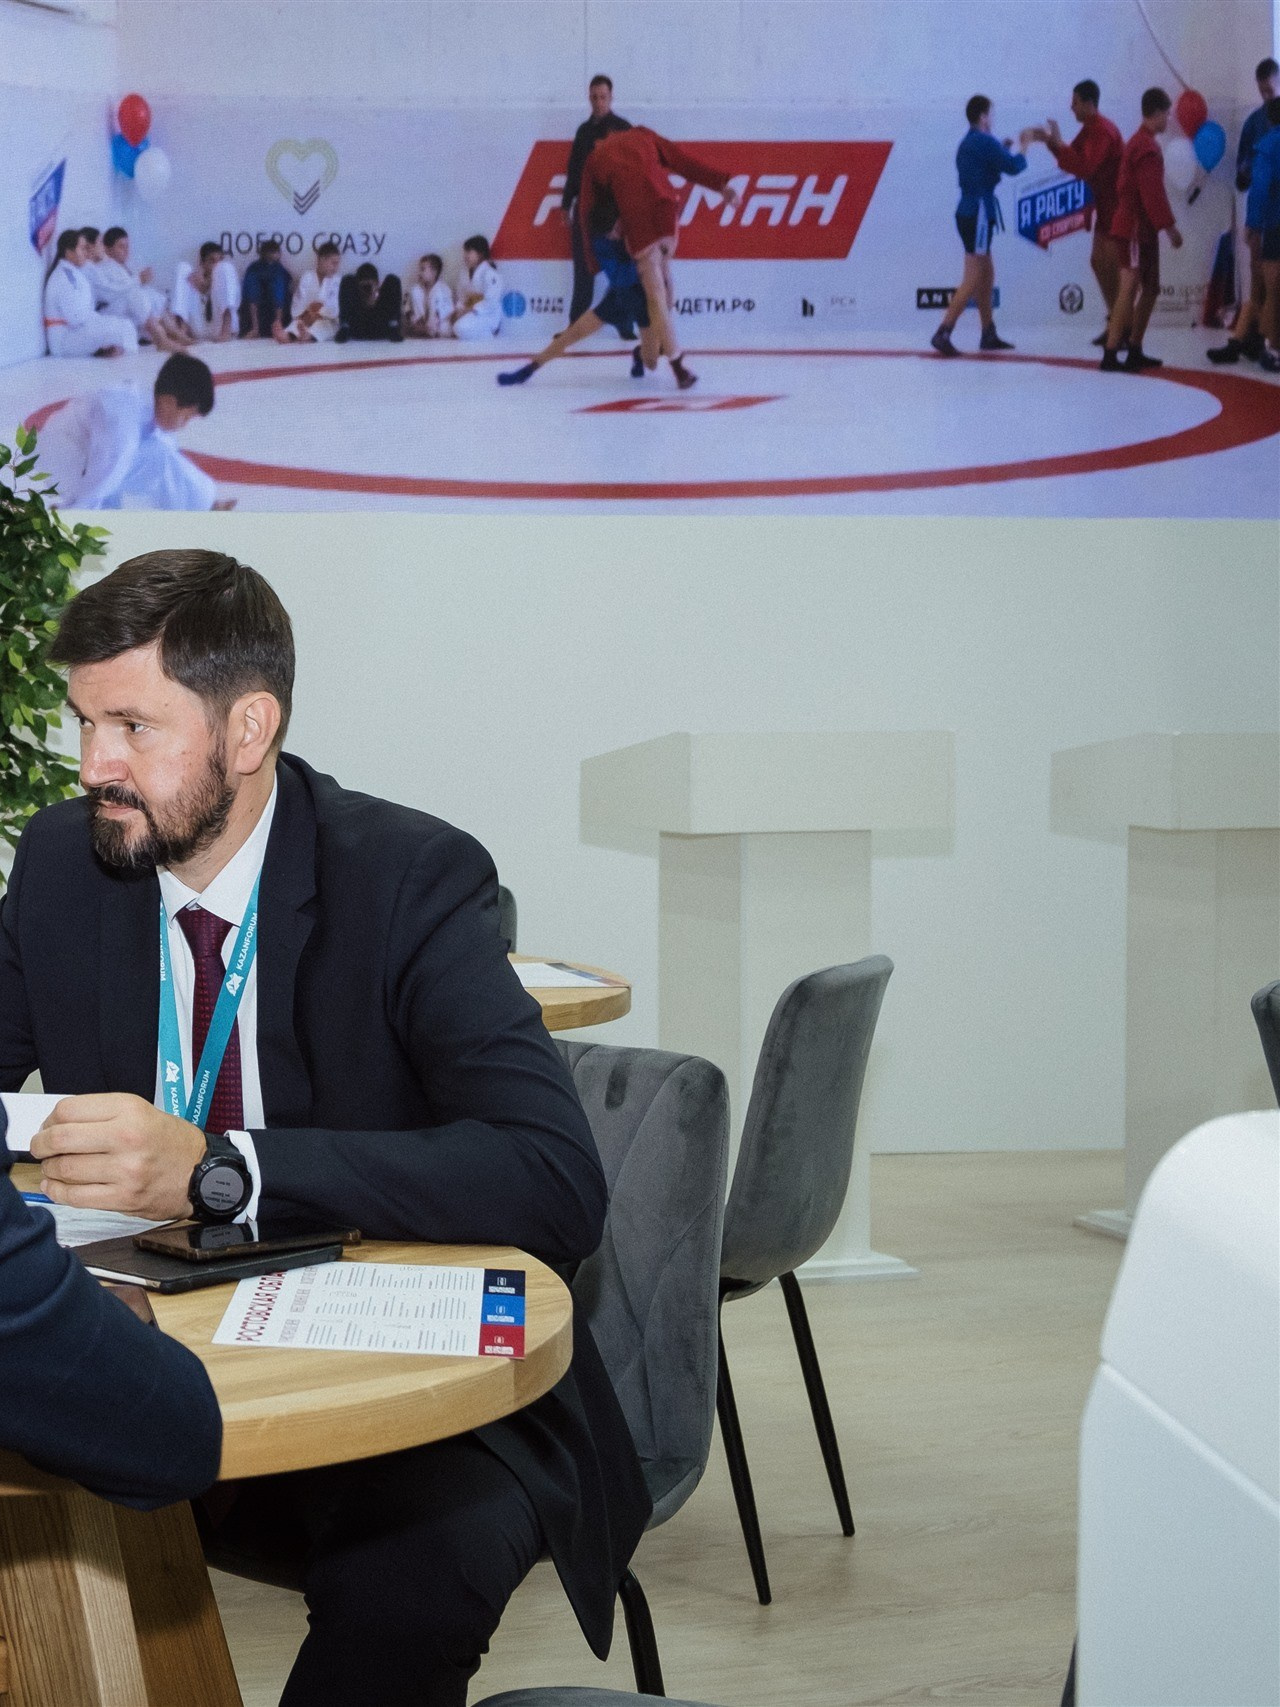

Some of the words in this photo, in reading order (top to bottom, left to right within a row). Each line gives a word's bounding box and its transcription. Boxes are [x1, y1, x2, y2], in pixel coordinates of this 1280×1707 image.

[1035, 180, 1085, 223] РАСТУ
[236, 912, 258, 971] KAZANFORUM
[170, 1086, 181, 1118] KAZAN
[191, 1069, 211, 1126] KAZANFORUM
[235, 1292, 279, 1342] РОСТОВСКАЯ
